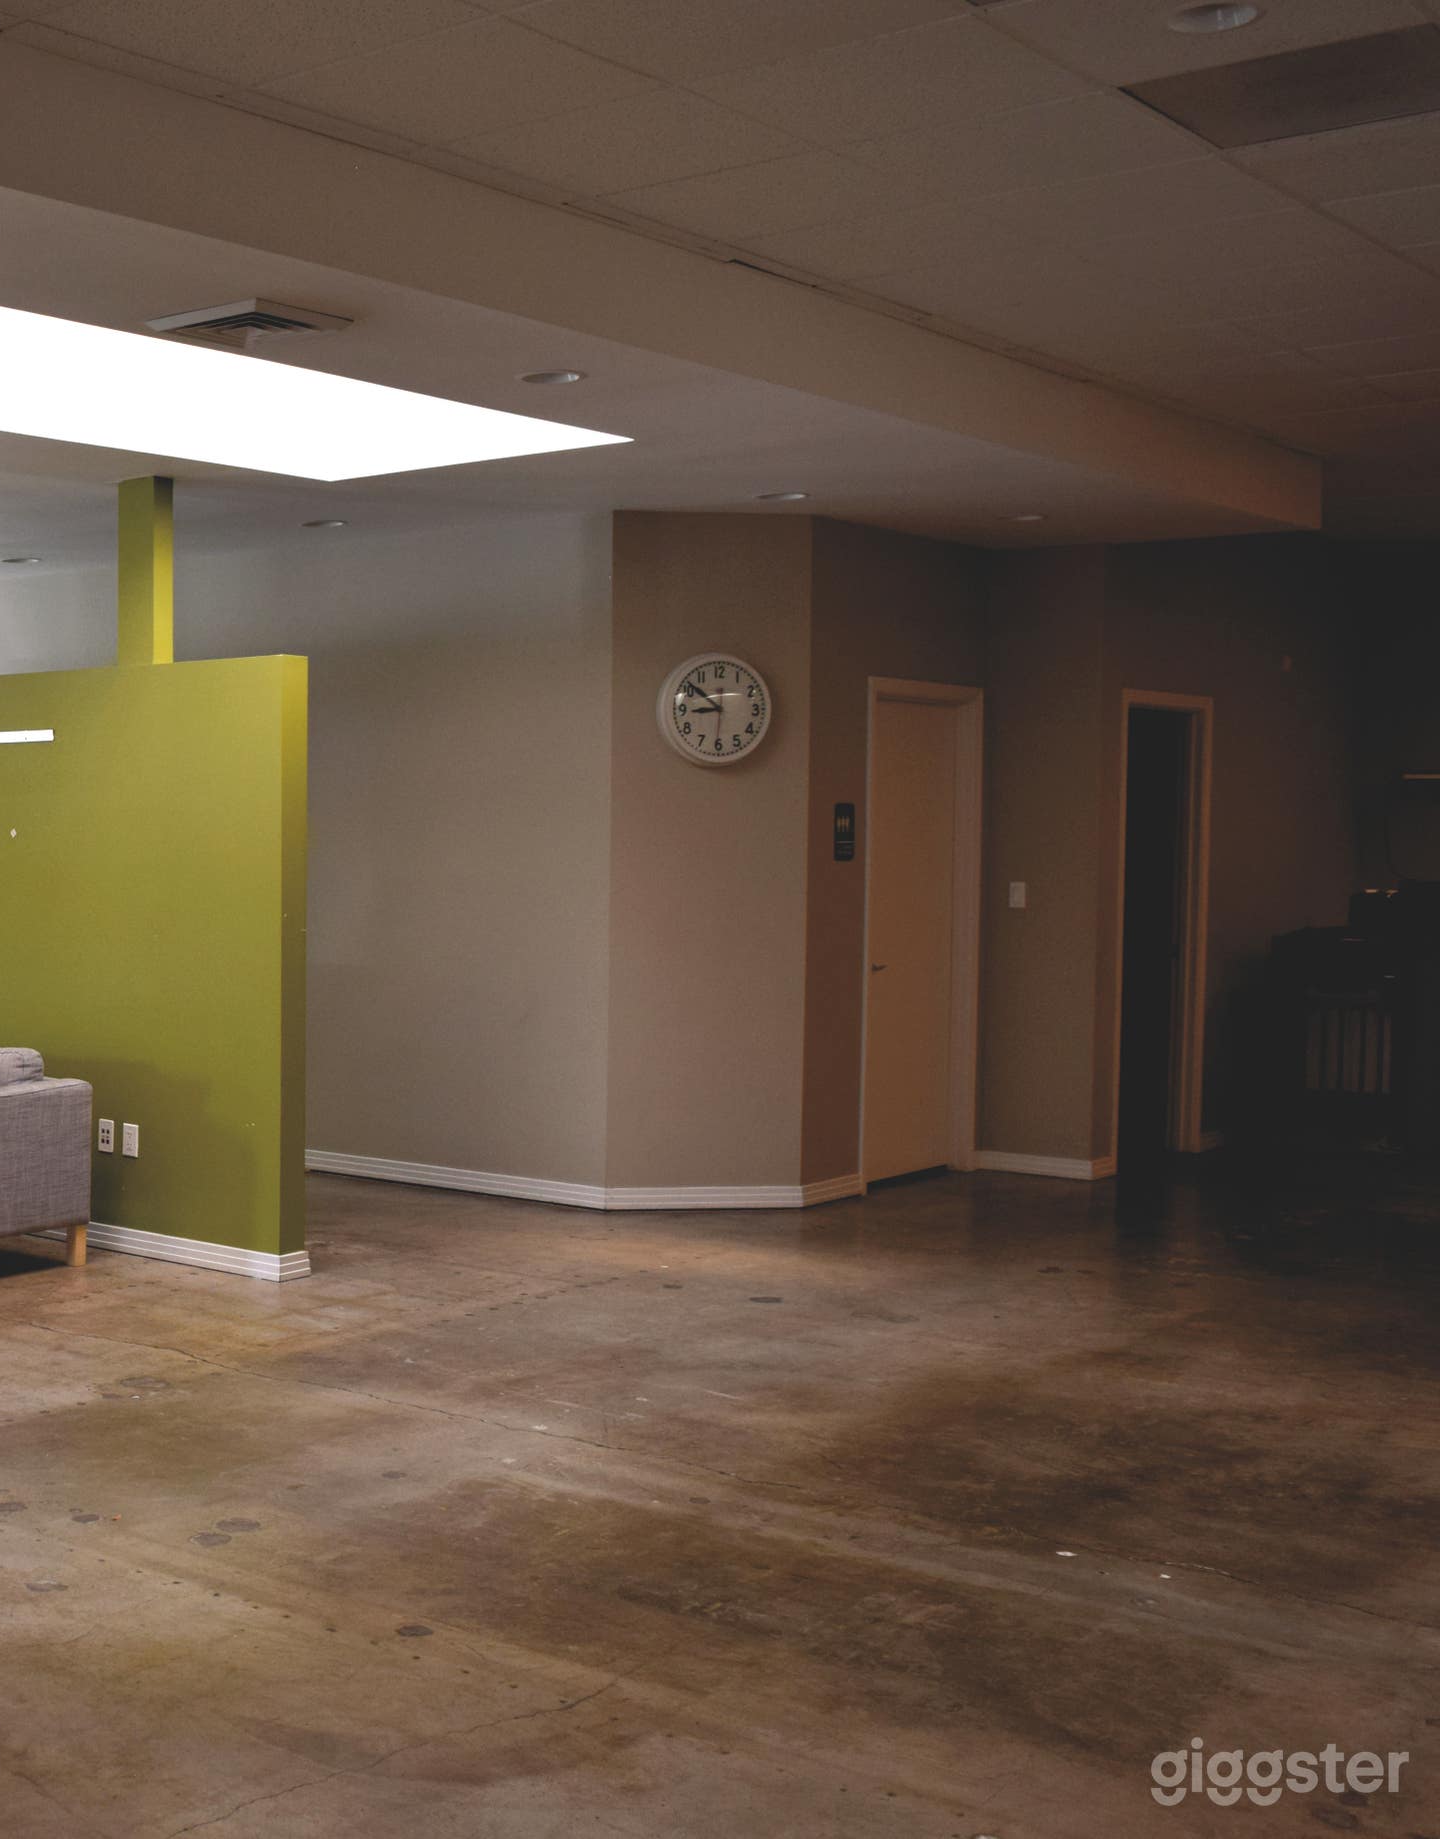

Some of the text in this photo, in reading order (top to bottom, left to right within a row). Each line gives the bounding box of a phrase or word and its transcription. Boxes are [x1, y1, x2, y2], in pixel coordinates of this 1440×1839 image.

[697, 671, 705, 683] 11
[714, 666, 725, 679] 12
[683, 684, 694, 698] 10
[747, 685, 755, 697] 2
[678, 704, 687, 716] 9
[751, 703, 760, 716] 3
[683, 722, 692, 735] 8
[745, 722, 754, 735] 4
[698, 734, 706, 747] 7
[714, 738, 723, 751] 6
[732, 734, 741, 747] 5
